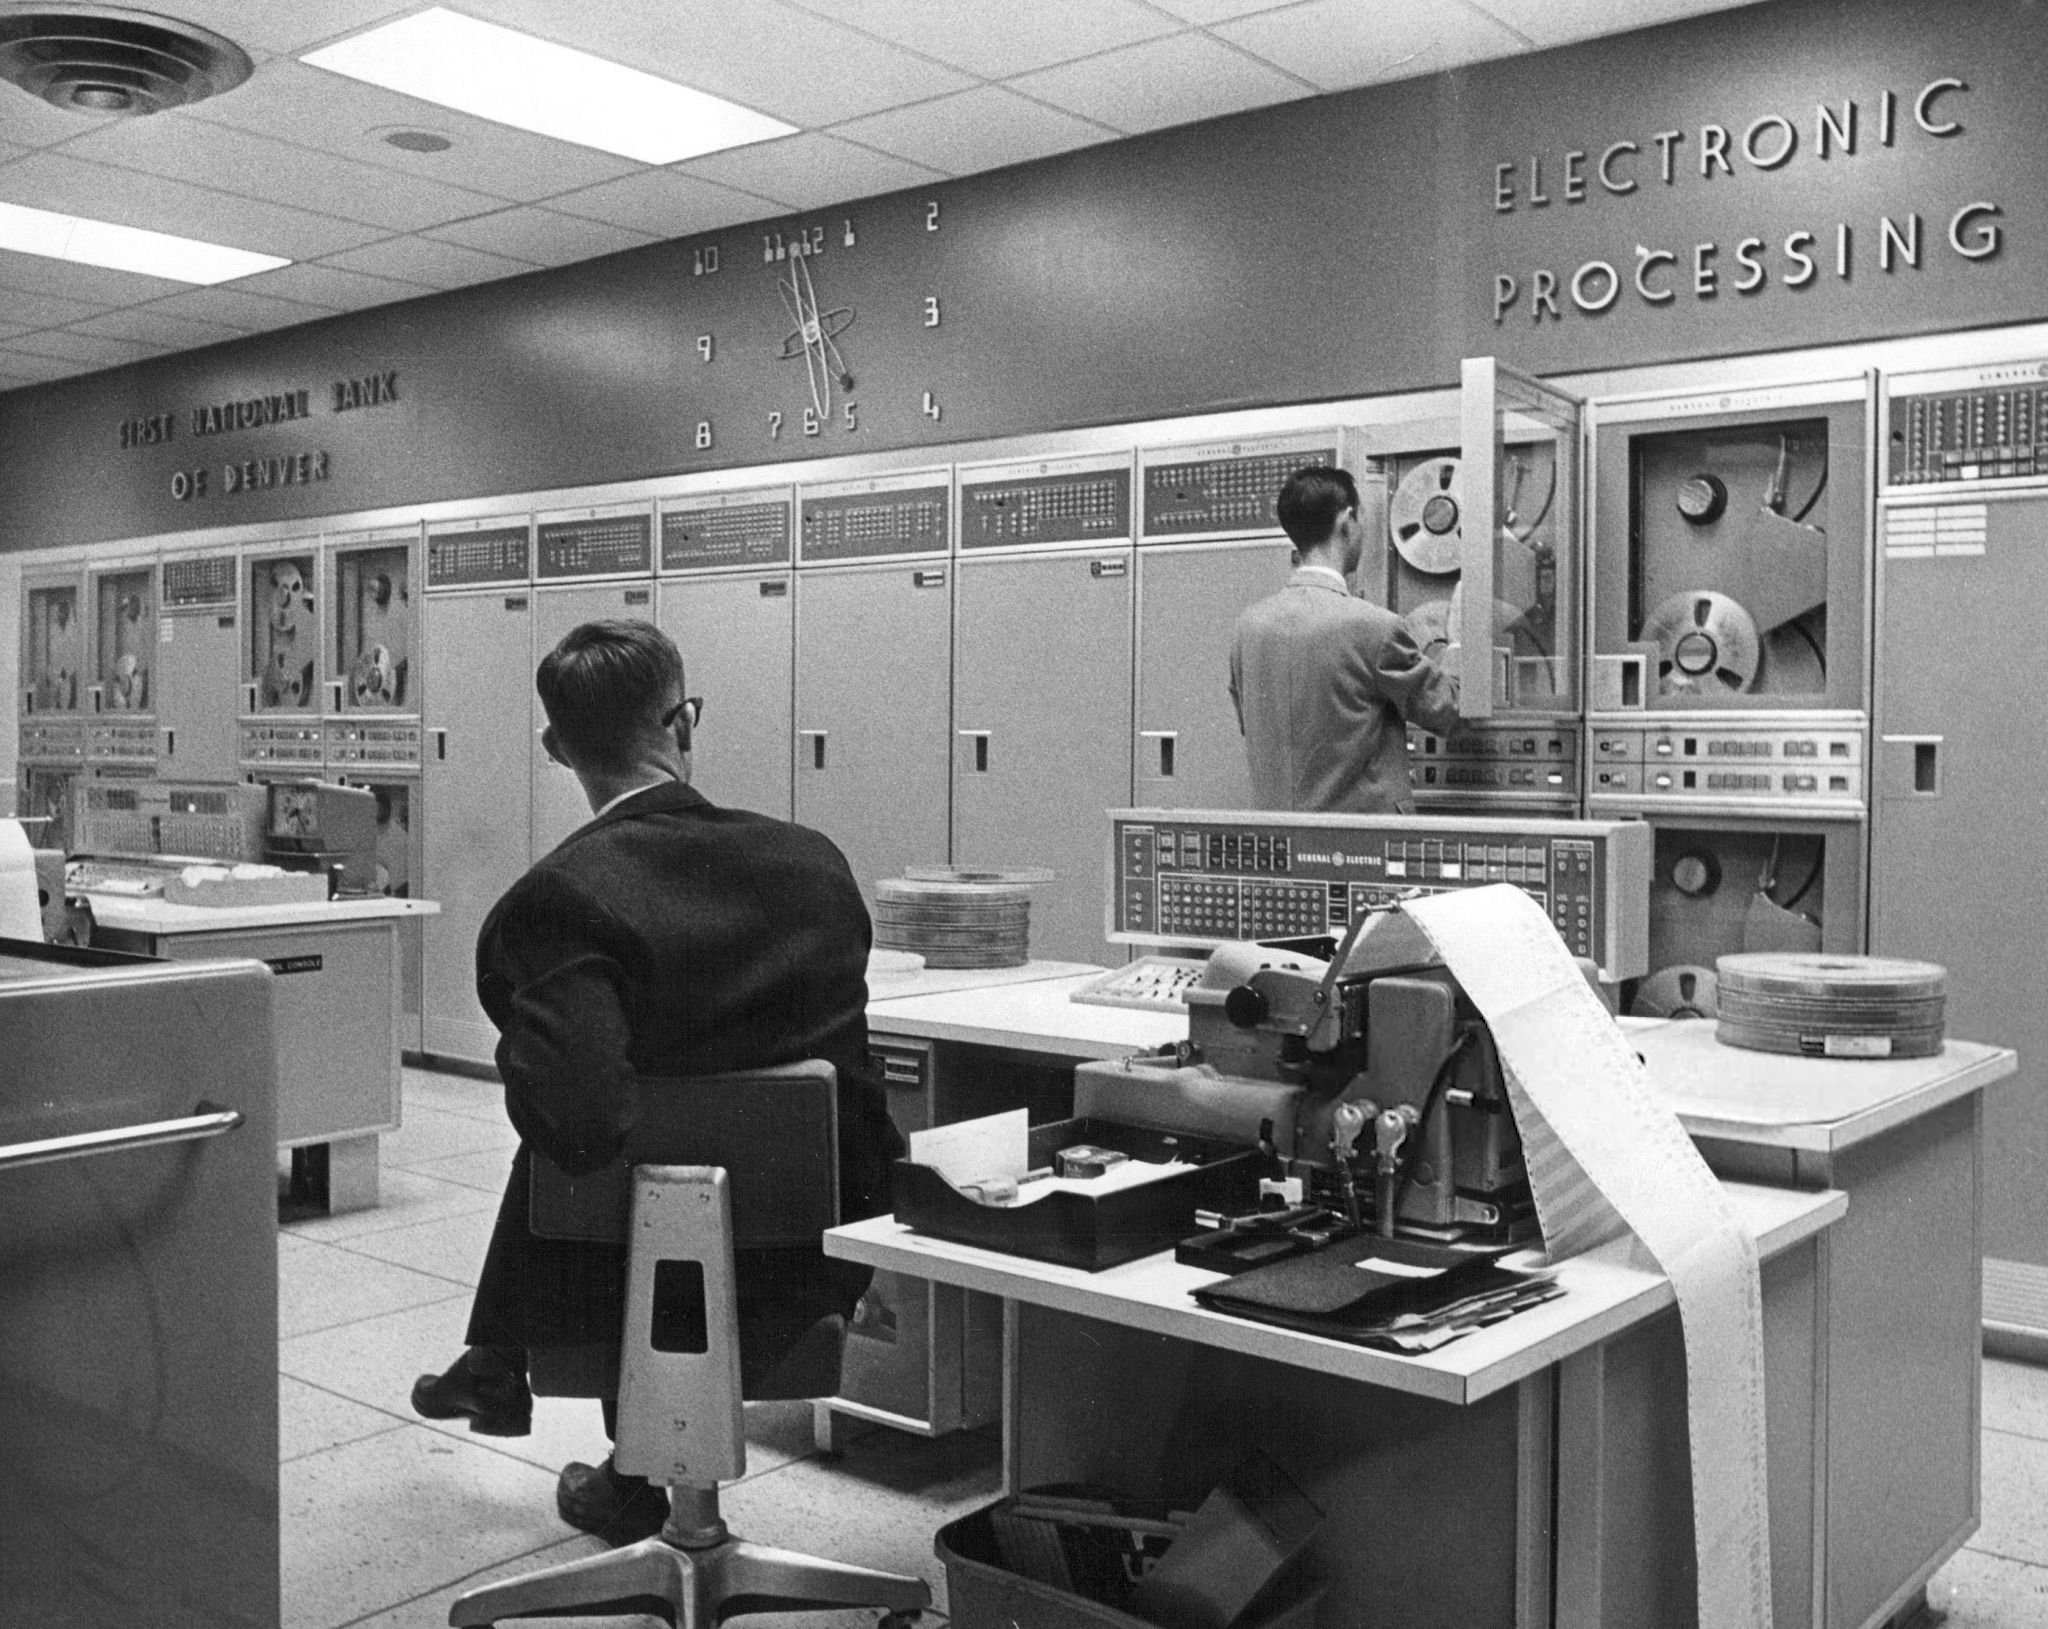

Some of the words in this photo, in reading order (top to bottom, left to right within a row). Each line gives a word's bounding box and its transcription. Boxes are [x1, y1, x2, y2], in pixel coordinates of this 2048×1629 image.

[1495, 77, 1964, 210] ELECTRONIC
[927, 202, 938, 231] 2
[802, 227, 824, 255] 12
[844, 220, 855, 246] 1
[694, 246, 718, 275] 10
[764, 234, 786, 262] 11
[1494, 201, 1999, 321] PROCESSING
[925, 297, 939, 327] 3
[697, 335, 711, 361] 9
[118, 413, 171, 448] FIRST
[191, 390, 306, 436] NATIONAL
[332, 372, 396, 411] ANK
[845, 402, 856, 430] 5
[923, 392, 939, 420] 4
[696, 422, 711, 448] 8
[769, 412, 781, 438] 7
[804, 408, 819, 435] 6
[171, 468, 205, 499] OF
[224, 450, 326, 493] DENVER
[1600, 742, 1610, 751] C
[1297, 853, 1331, 863] GENERAL
[1346, 855, 1381, 866] ELECTRIC
